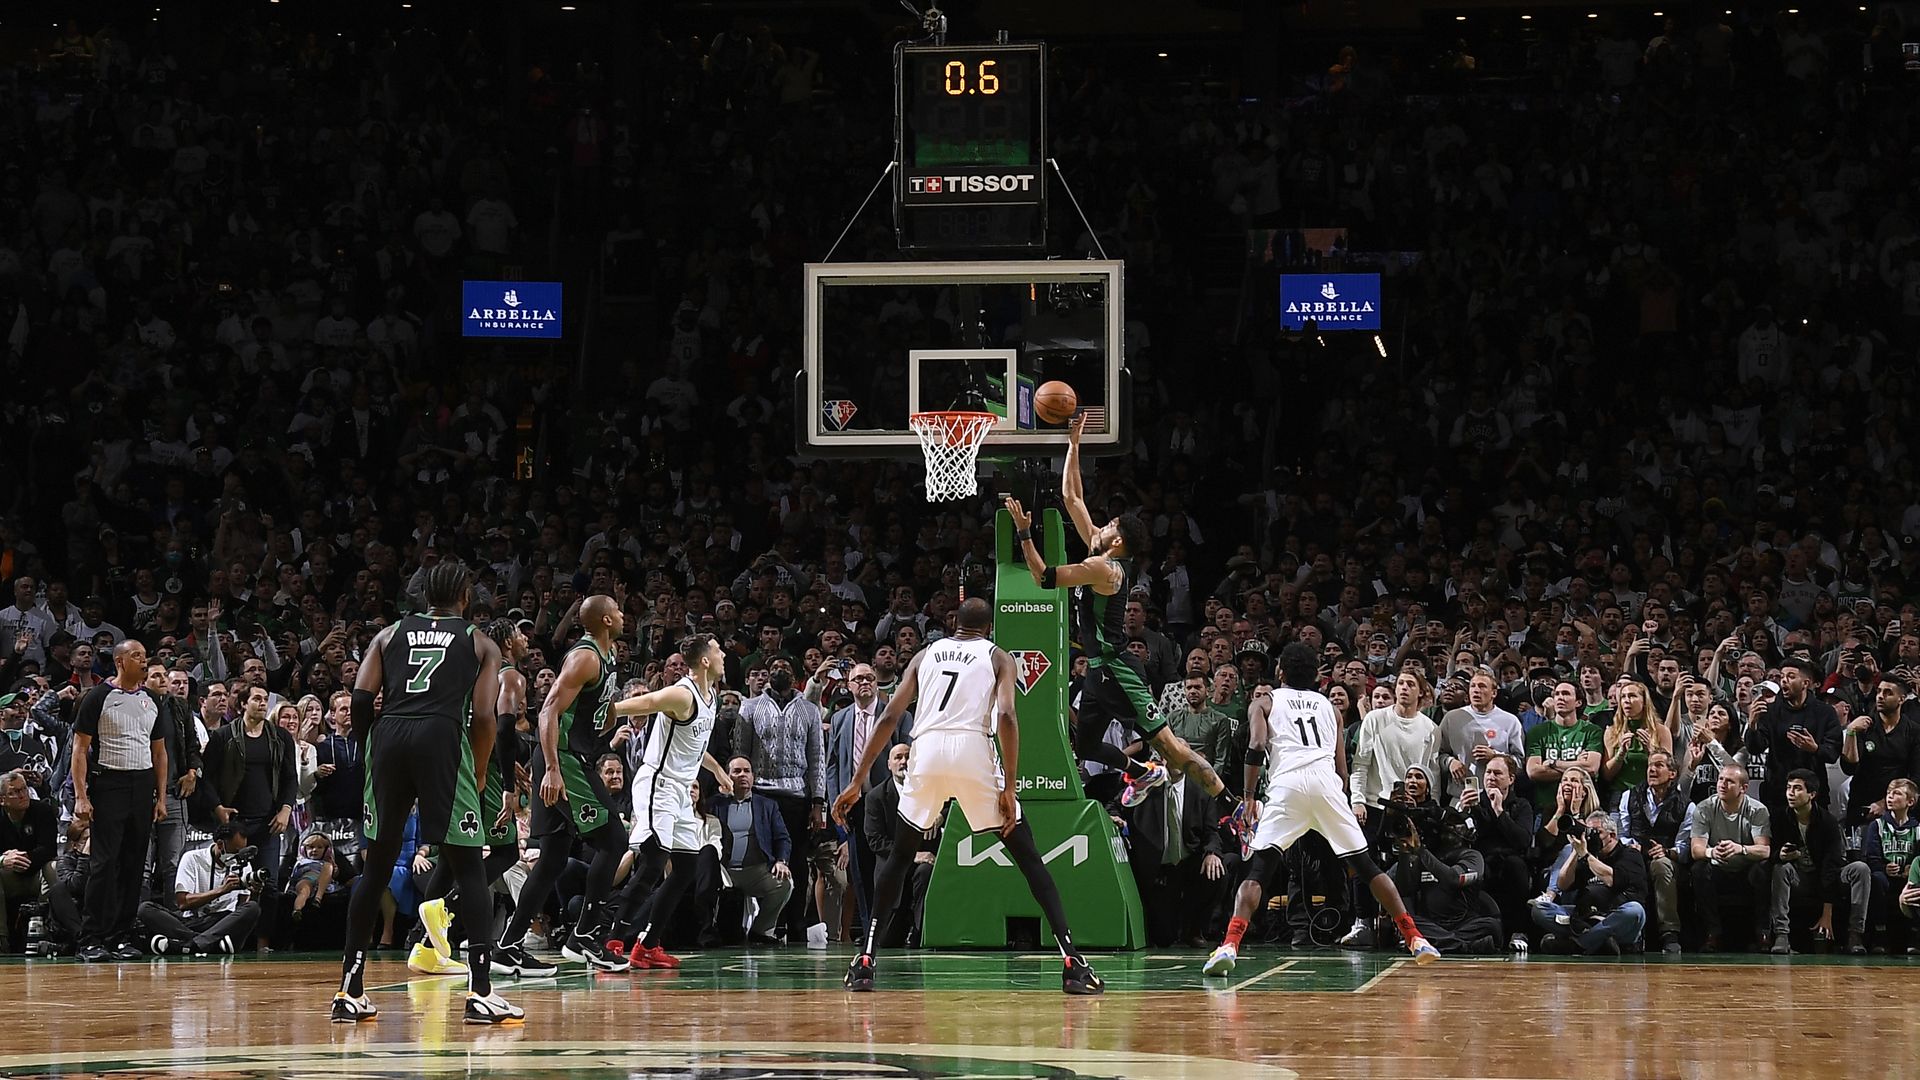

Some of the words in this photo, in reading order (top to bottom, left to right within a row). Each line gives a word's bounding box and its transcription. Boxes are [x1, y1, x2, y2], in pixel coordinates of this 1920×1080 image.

[945, 60, 999, 95] 0.6
[944, 174, 1034, 192] TISSOT
[468, 307, 556, 320] ARBELLA
[1286, 300, 1374, 313] ARBELLA
[480, 321, 544, 329] INSURANCE
[1000, 602, 1054, 613] coinbase
[406, 631, 456, 648] BROWN
[934, 651, 977, 666] DURANT
[1030, 657, 1040, 671] 75
[406, 647, 446, 693] 7
[938, 670, 959, 712] 7
[1287, 699, 1320, 711] IRVING
[593, 701, 610, 730] 4
[1294, 716, 1322, 748] 11
[1015, 775, 1034, 793] gle
[1036, 775, 1067, 790] Pixel
